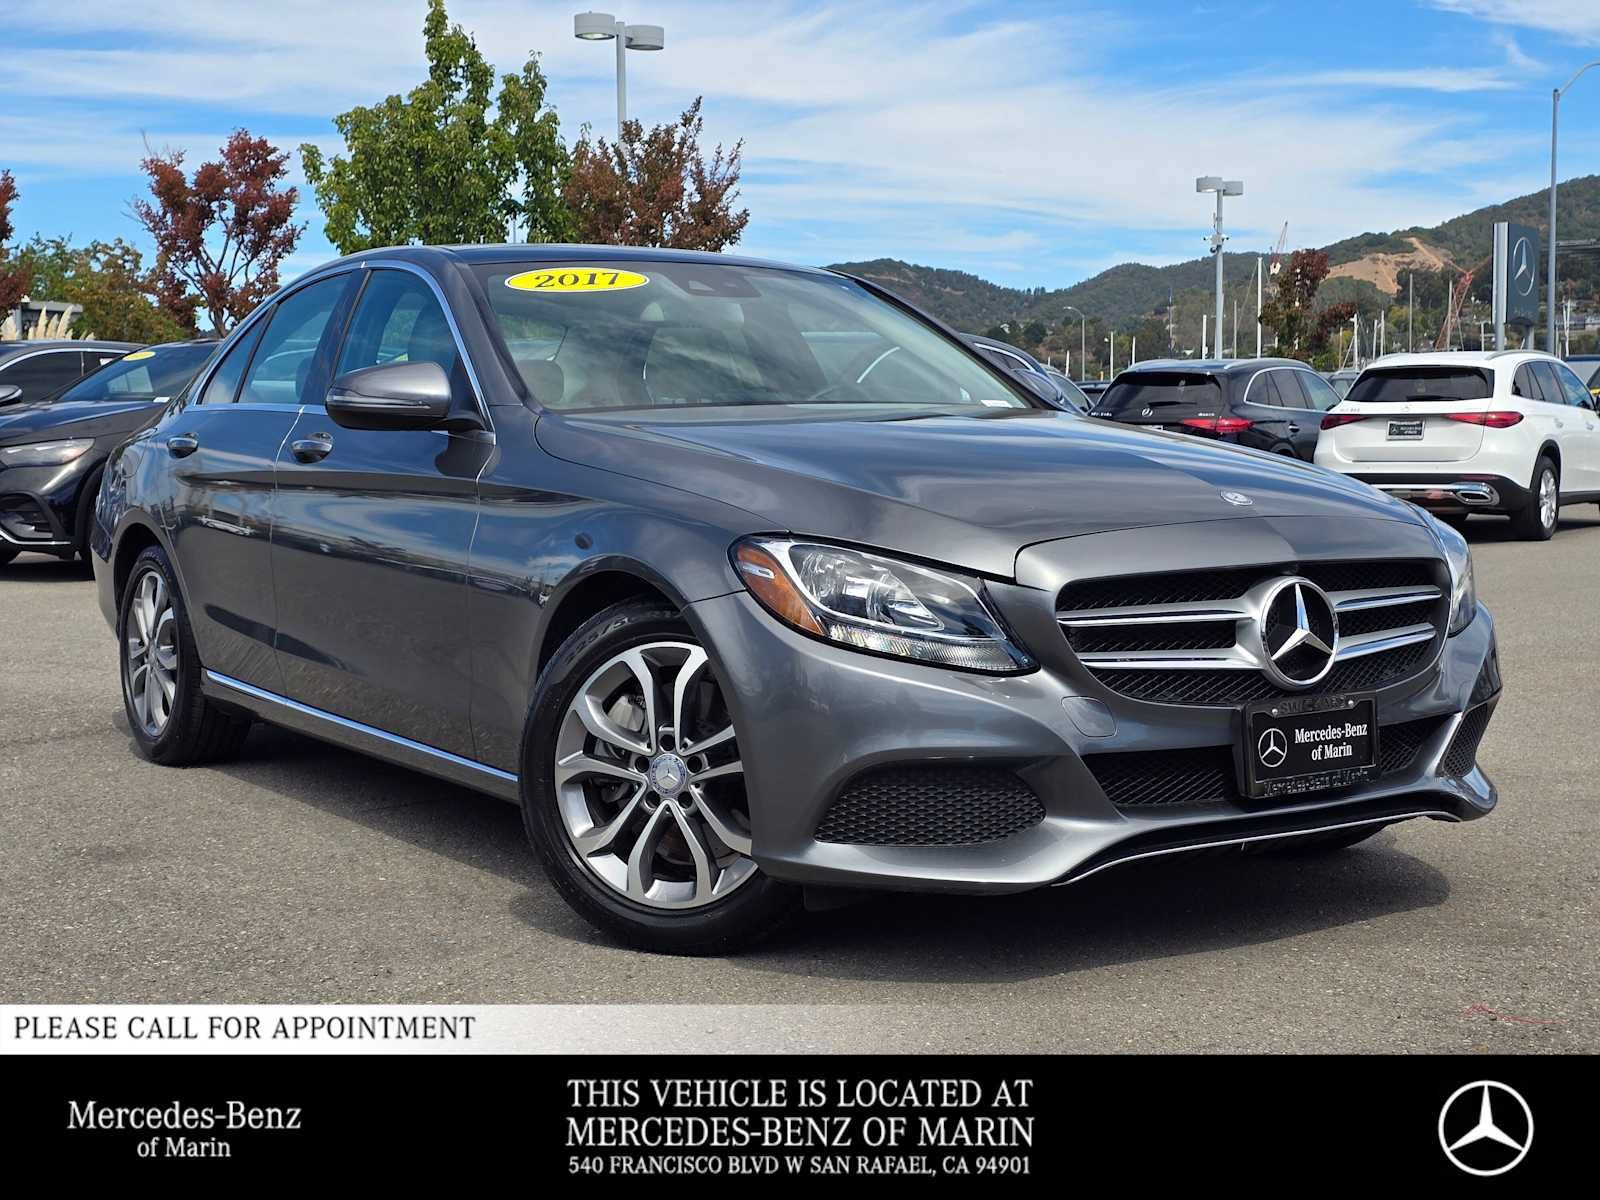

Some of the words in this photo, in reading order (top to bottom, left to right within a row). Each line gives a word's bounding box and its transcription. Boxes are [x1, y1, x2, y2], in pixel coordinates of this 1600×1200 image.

[534, 272, 620, 288] 2017
[1294, 722, 1368, 744] Mercedes-Benz
[1311, 745, 1323, 761] of
[1323, 741, 1353, 760] Marin
